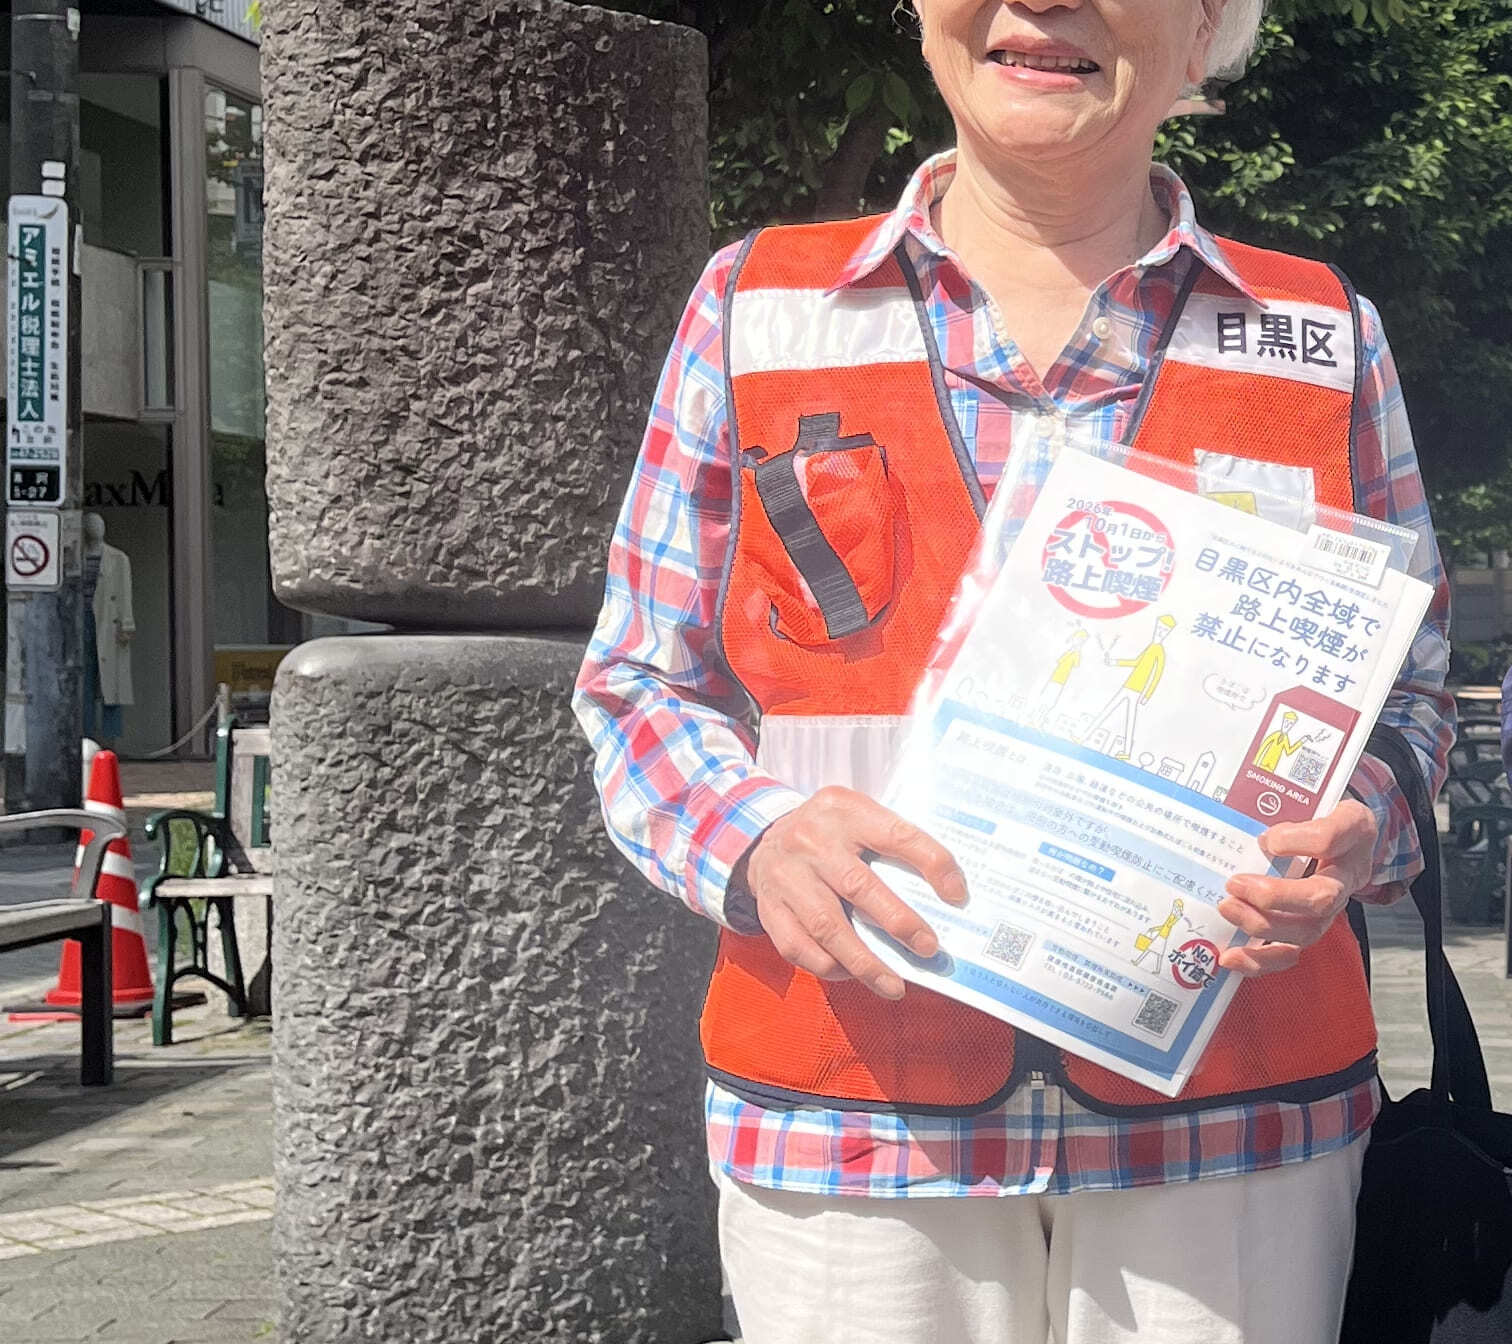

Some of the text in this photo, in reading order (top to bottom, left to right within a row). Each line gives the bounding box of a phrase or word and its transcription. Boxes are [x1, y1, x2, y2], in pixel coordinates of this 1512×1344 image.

[1217, 312, 1338, 368] 目黒区
[1066, 497, 1113, 517] 2026年
[1048, 528, 1176, 572] ストップ！
[1086, 516, 1166, 544] 10月1日から
[1041, 558, 1164, 602] 路上喫煙
[1194, 547, 1382, 637] 目黒区内全域で
[1230, 593, 1369, 663] 路上喫煙が
[1190, 612, 1357, 694] 禁止になります
[1246, 769, 1311, 807] SMOKING AREA
[1168, 948, 1217, 990] ポイ捨て
[1191, 945, 1215, 967] No!
